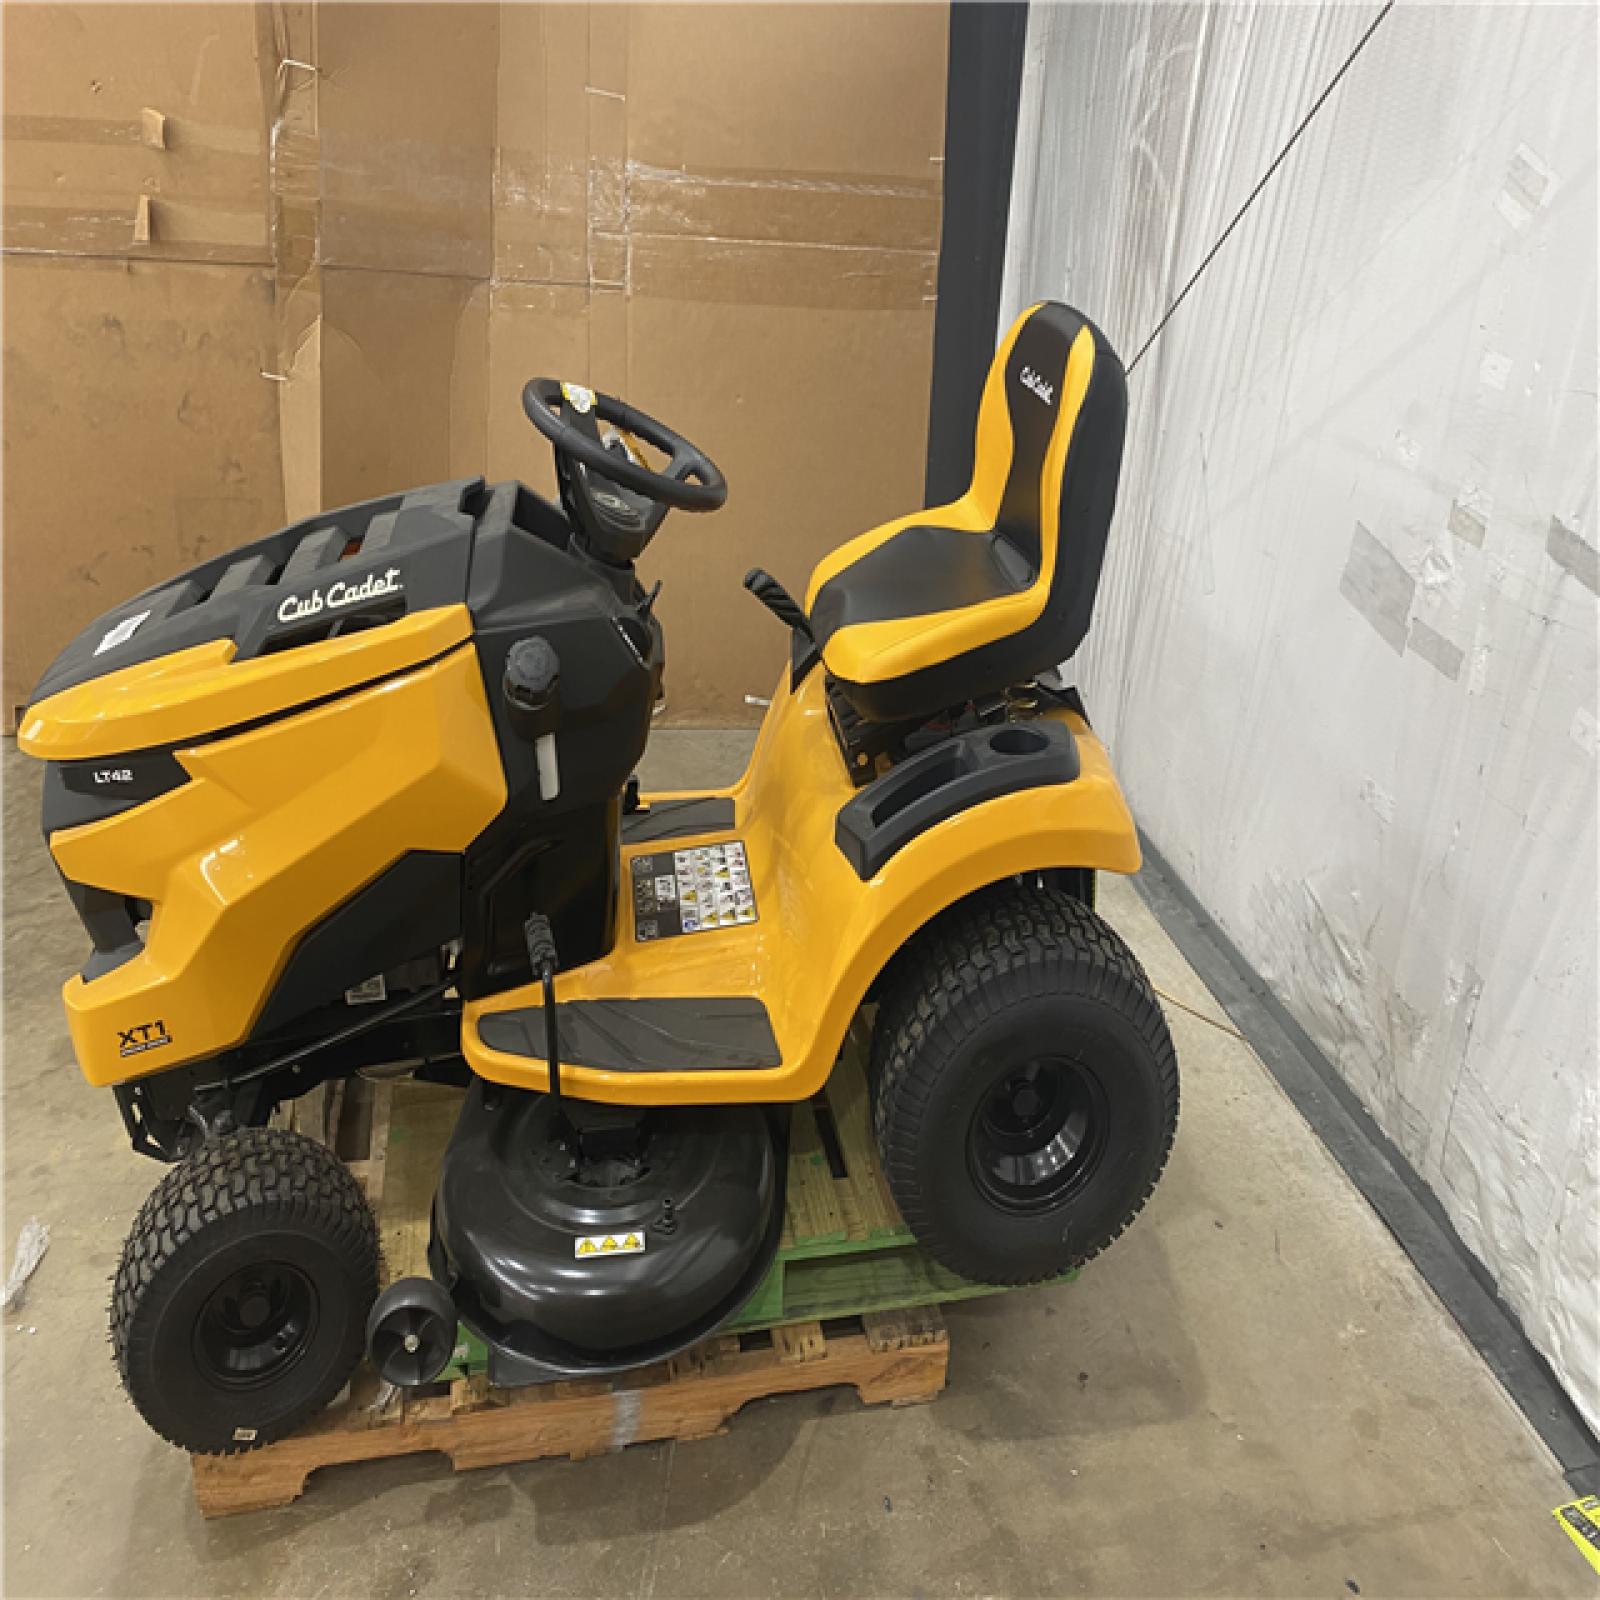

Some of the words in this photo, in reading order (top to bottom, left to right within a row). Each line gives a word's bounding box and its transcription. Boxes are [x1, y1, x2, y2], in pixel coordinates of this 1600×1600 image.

[277, 594, 323, 622] Cub
[326, 567, 401, 608] Cadet
[117, 1019, 165, 1046] XT1
